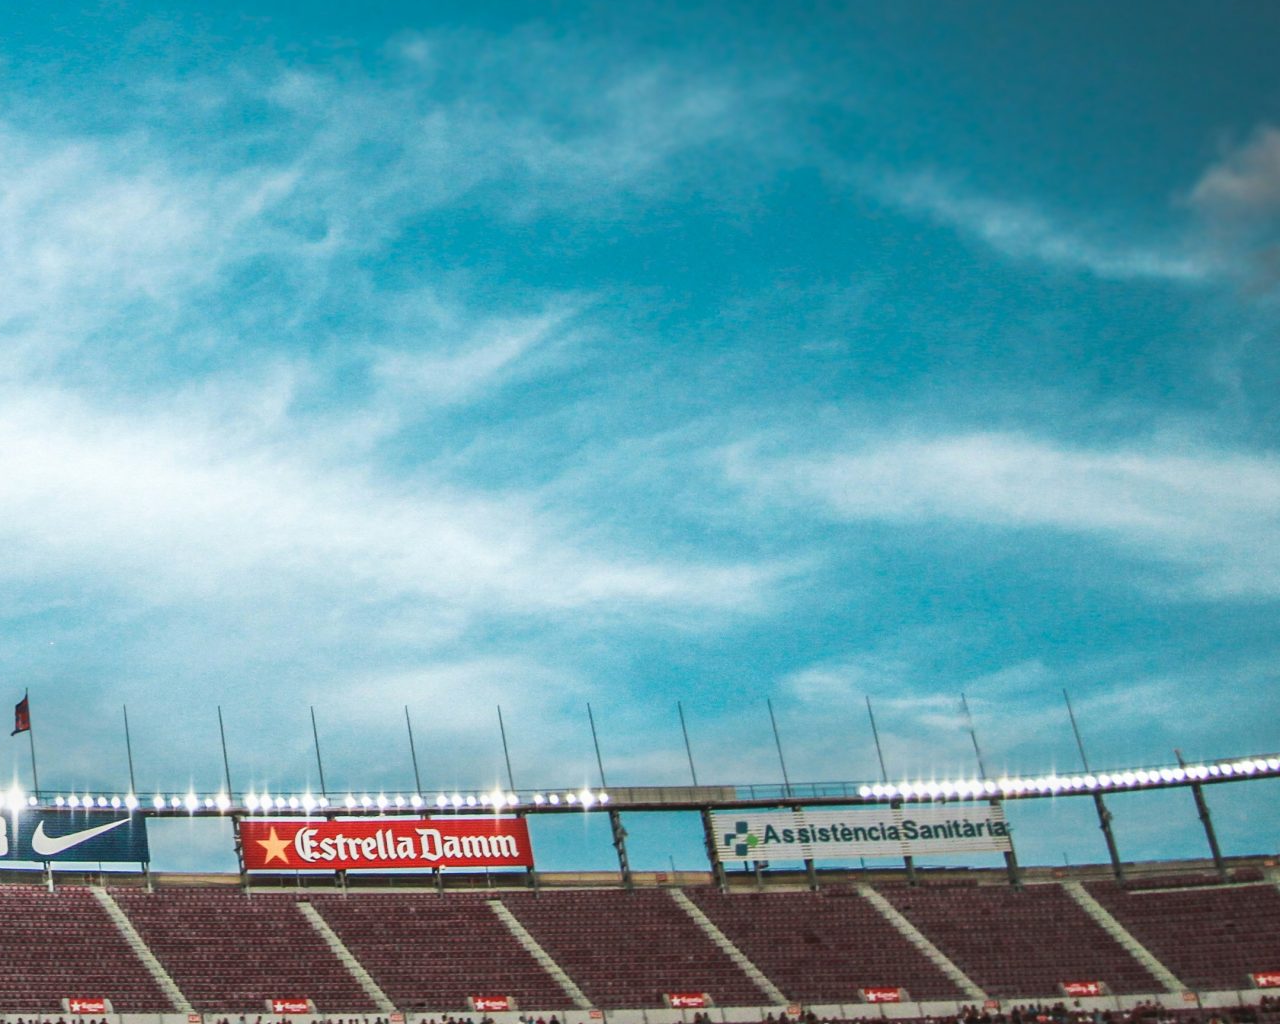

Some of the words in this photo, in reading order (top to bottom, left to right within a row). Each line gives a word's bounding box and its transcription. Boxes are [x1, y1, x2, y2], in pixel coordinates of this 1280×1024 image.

[294, 826, 417, 862] Estrella
[415, 828, 519, 859] Damm
[763, 823, 900, 844] Assistència
[901, 818, 1007, 840] Sanitària
